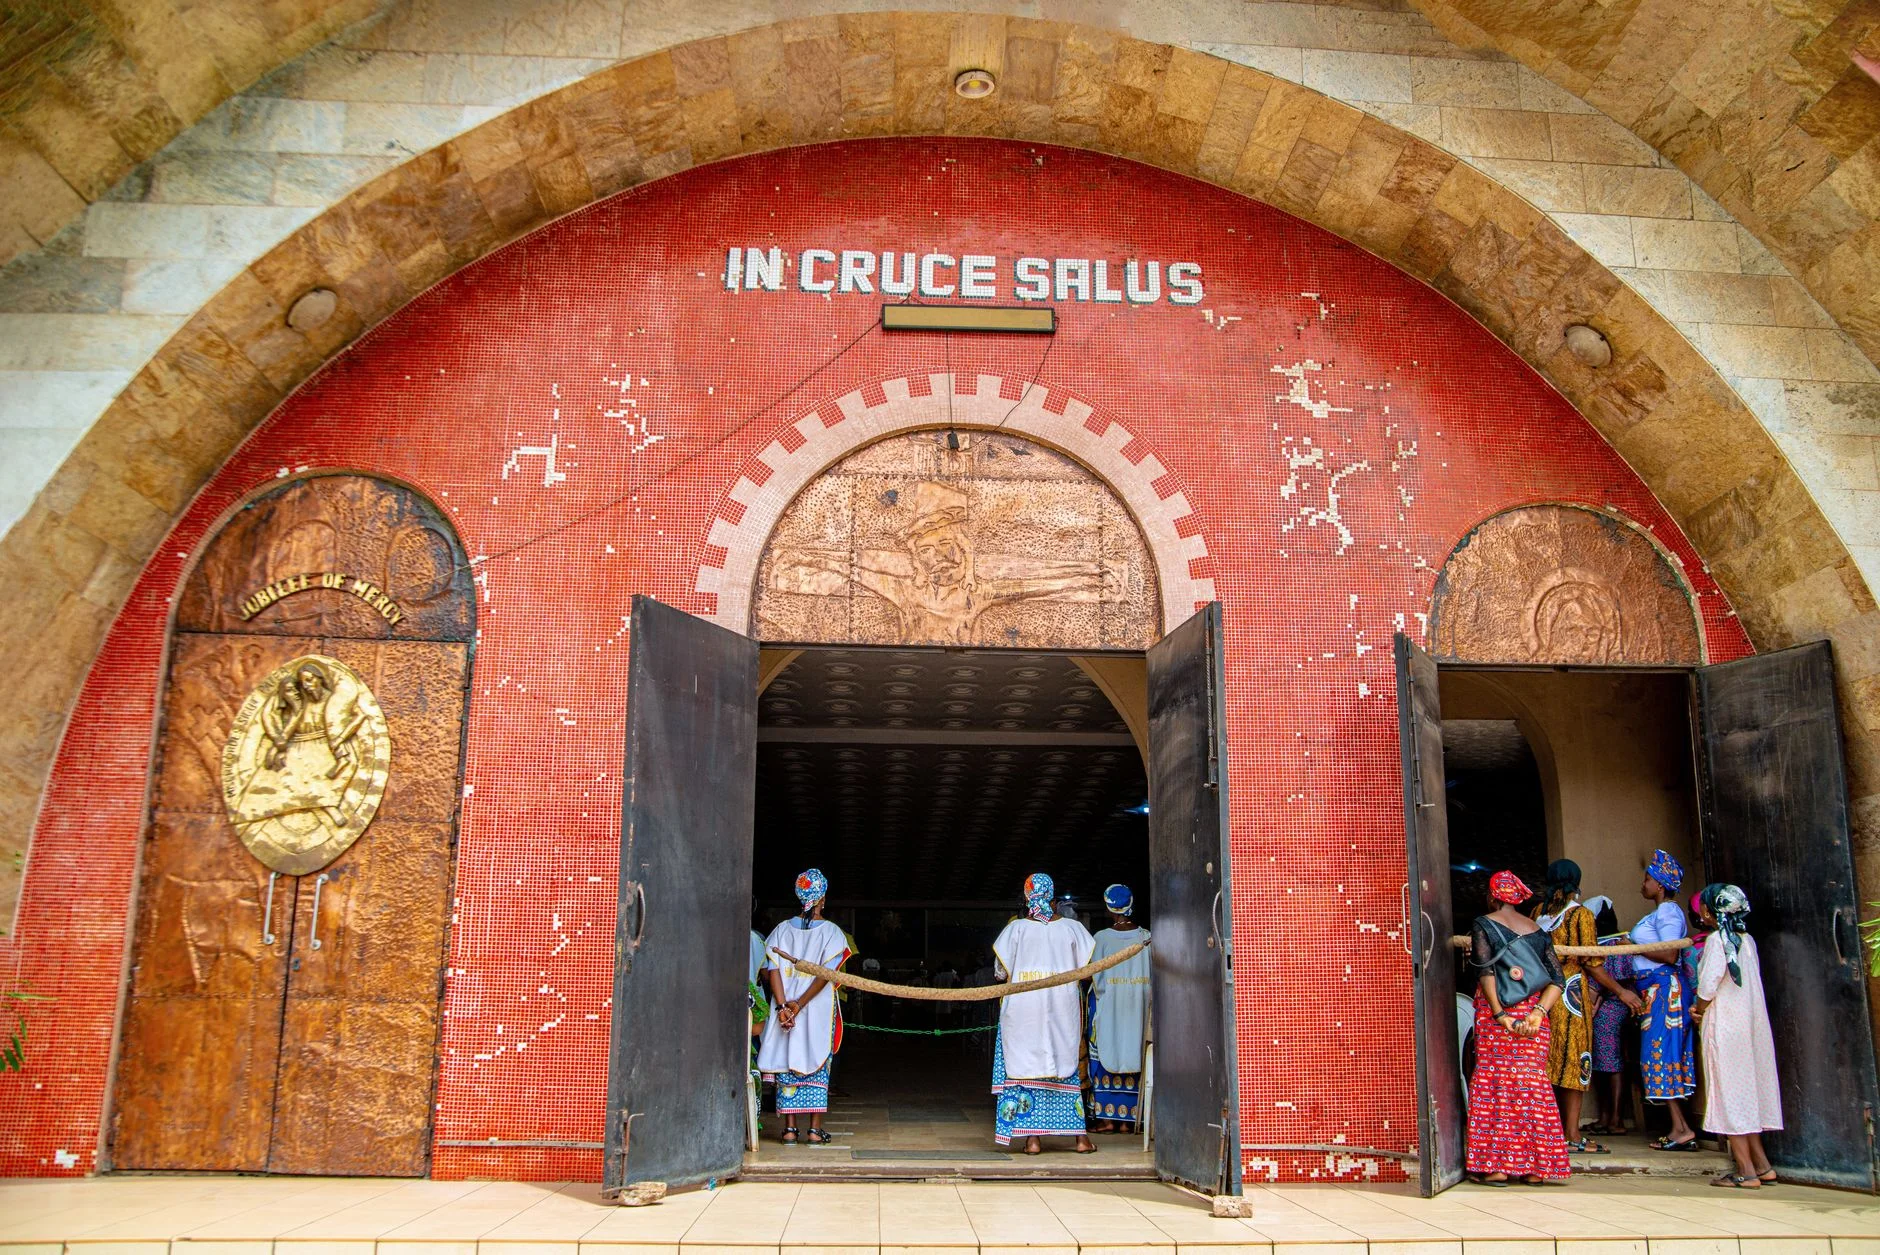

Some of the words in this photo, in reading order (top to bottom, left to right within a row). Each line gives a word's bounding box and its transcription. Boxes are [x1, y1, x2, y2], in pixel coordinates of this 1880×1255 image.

[723, 247, 784, 291] IN
[799, 249, 997, 298] CRUCE
[1014, 257, 1204, 304] SALUS
[239, 573, 312, 622] JUBILEE
[321, 572, 347, 589] OF
[352, 578, 407, 627] MERCY
